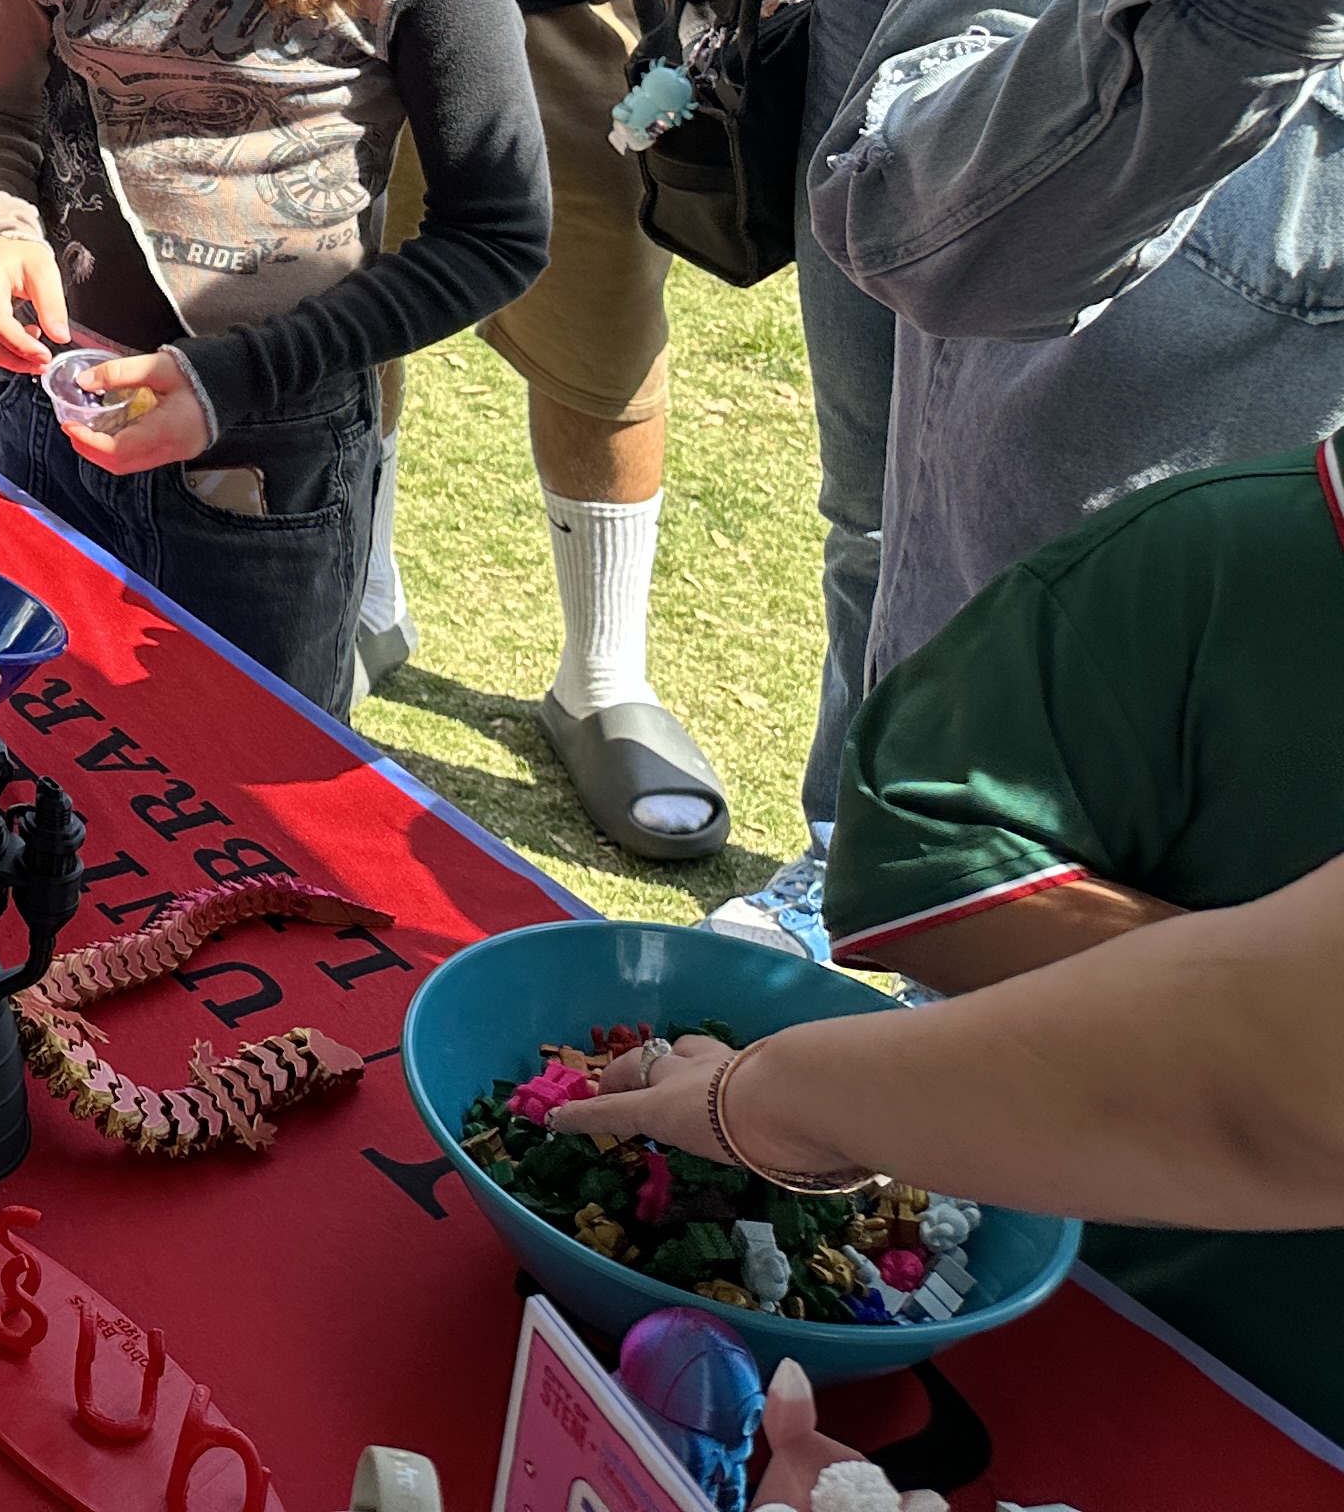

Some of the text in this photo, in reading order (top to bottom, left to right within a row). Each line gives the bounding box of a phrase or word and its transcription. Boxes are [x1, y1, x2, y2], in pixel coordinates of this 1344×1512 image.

[187, 243, 247, 272] RIDE
[70, 1296, 150, 1368] ohn Bas
